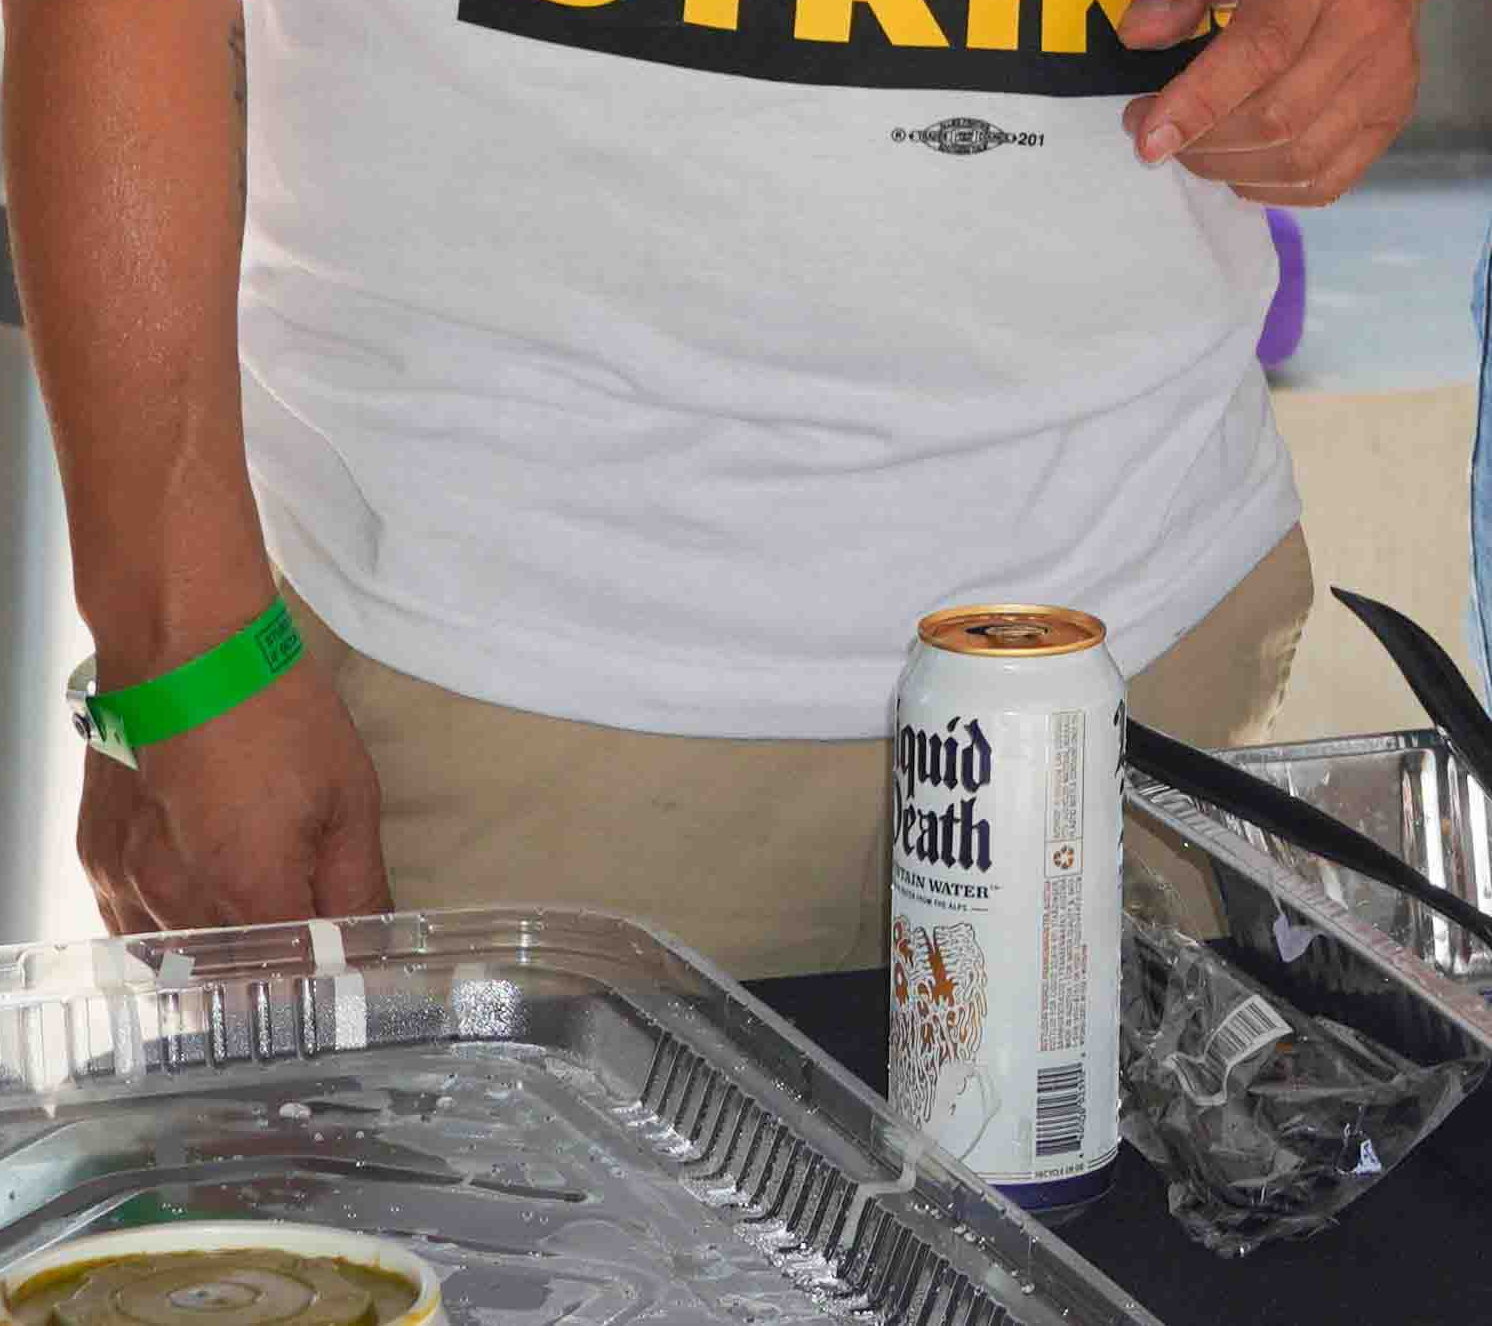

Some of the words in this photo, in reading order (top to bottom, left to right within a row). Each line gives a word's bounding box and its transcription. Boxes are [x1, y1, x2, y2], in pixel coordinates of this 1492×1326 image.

[1018, 131, 1045, 147] 201
[893, 715, 993, 799] quid
[928, 878, 989, 899] WATER
